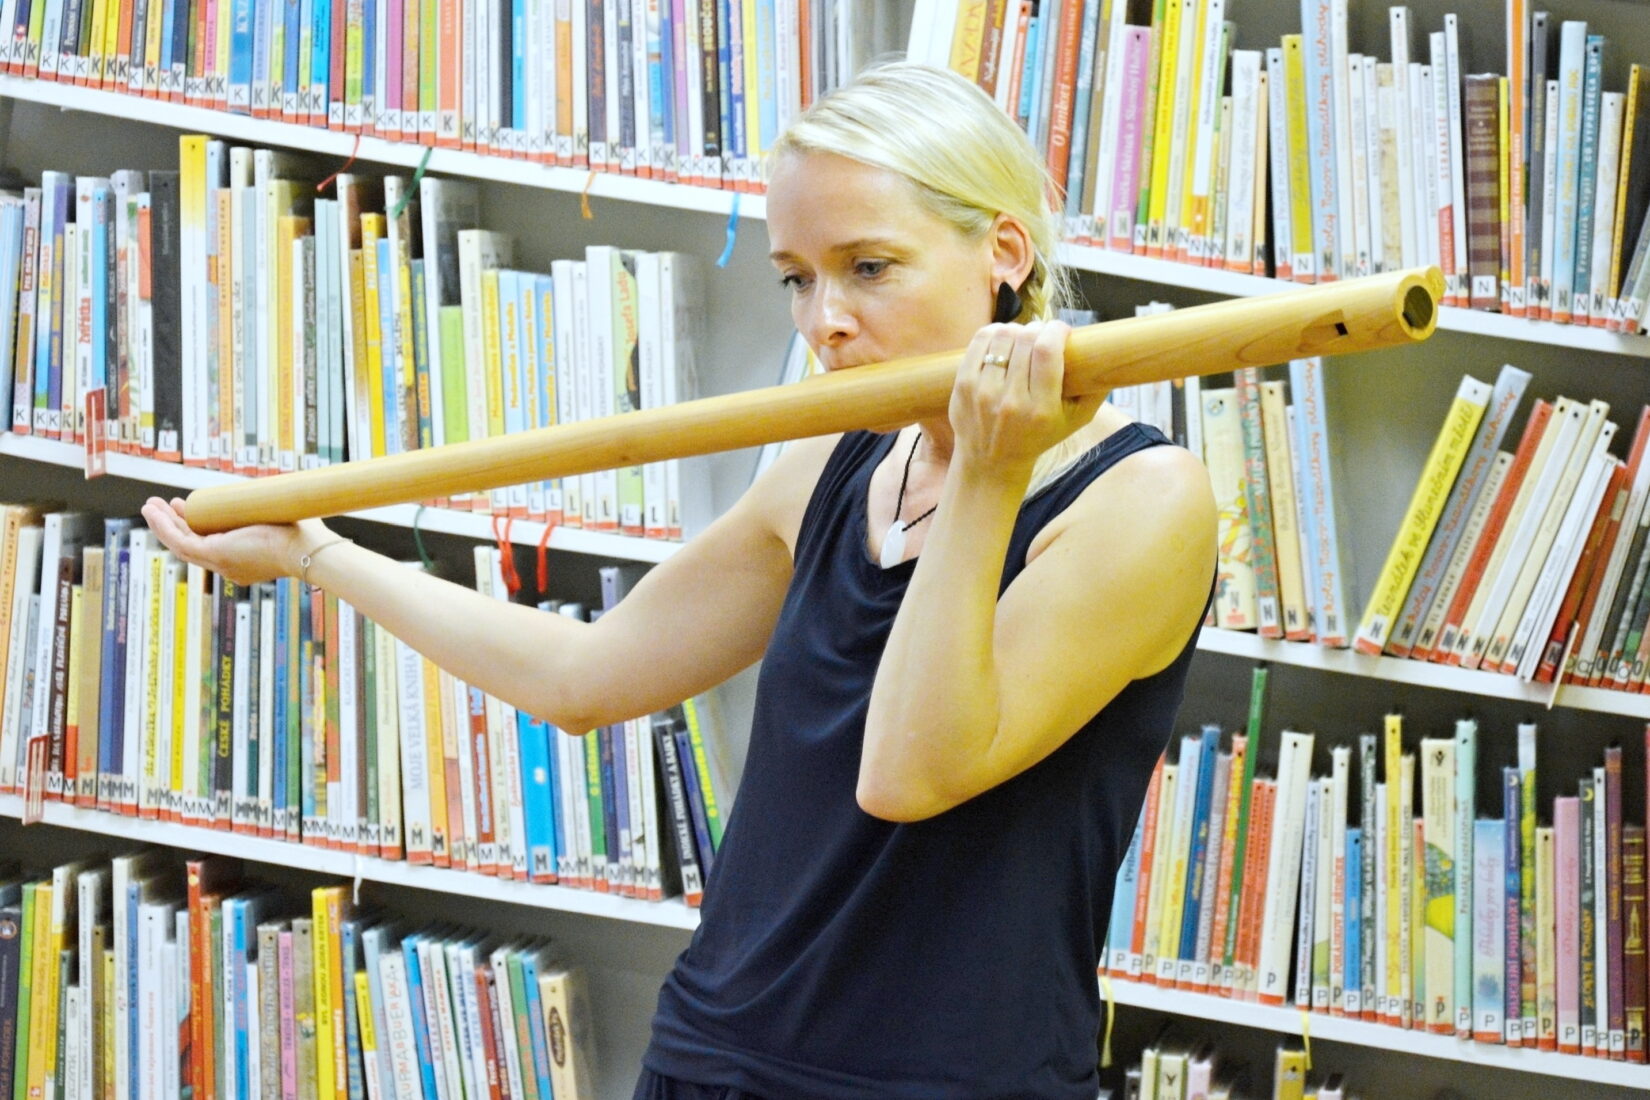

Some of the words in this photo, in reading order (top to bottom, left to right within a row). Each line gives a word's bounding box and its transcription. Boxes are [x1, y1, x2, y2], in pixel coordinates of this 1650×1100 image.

[698, 0, 714, 51] BROUČC
[14, 41, 23, 58] K
[27, 44, 36, 59] K
[43, 56, 51, 66] K
[60, 59, 69, 70] K
[92, 58, 100, 72] K
[129, 72, 137, 84] K
[147, 68, 155, 83] K
[205, 77, 214, 93] K
[285, 98, 293, 109] K
[1583, 77, 1597, 142] VYPRÁVĚLA
[331, 107, 340, 118] K
[348, 110, 355, 120] K
[444, 116, 452, 130] K
[545, 131, 552, 145] K
[1436, 116, 1450, 179] STRAKATÉ
[638, 150, 646, 161] K
[665, 151, 674, 166] K
[1582, 149, 1592, 162] CO
[1580, 176, 1592, 211] Nepil
[1151, 228, 1158, 241] N
[1576, 215, 1590, 274] František
[1479, 281, 1489, 292] N
[16, 409, 24, 420] K
[36, 413, 44, 423] K
[49, 415, 56, 425] K
[163, 435, 170, 448] L
[208, 440, 216, 454] L
[513, 490, 520, 503] L
[550, 493, 558, 506] L
[569, 495, 576, 512] L
[585, 502, 592, 519] L
[603, 500, 609, 516] L
[652, 506, 658, 523] L
[672, 507, 679, 525] L
[1264, 606, 1272, 618] N
[1288, 611, 1296, 622] N
[1372, 623, 1381, 637] N
[1422, 629, 1433, 644] N
[1458, 635, 1467, 649] N
[404, 654, 418, 699] KNIHA
[219, 656, 231, 712] POHÁDKY
[404, 703, 421, 748] VELKÁ
[218, 720, 229, 757] ČESKÉ
[1, 767, 8, 784] L
[410, 750, 423, 791] MOJE
[49, 776, 60, 787] M
[64, 780, 75, 791] M
[82, 779, 93, 794] M
[123, 783, 134, 797] M
[184, 801, 196, 812] M
[218, 797, 228, 811] M
[343, 827, 354, 837] M
[385, 827, 395, 840] M
[412, 829, 422, 843] M
[434, 836, 444, 850] M
[500, 845, 510, 858] M
[536, 854, 546, 869] M
[593, 865, 604, 878] M
[686, 873, 697, 889] M
[1333, 855, 1345, 905] DĚDEČEK
[316, 914, 324, 941] KRTEK
[1507, 897, 1520, 957] POHÁDKY
[1331, 910, 1343, 974] POHÁDKOVÝ
[1116, 953, 1125, 965] P
[1145, 954, 1153, 969] P
[1163, 961, 1173, 972] P
[1181, 964, 1192, 976] P
[1212, 964, 1222, 979] P
[1267, 972, 1276, 986] P
[1333, 987, 1342, 1002] P
[1347, 994, 1357, 1006] P
[1364, 989, 1374, 1004] P
[1389, 998, 1399, 1010] P
[1437, 1002, 1445, 1017] P
[1485, 1014, 1495, 1027] P
[1543, 1018, 1551, 1032] P
[1510, 1023, 1521, 1035] P
[1565, 1026, 1575, 1039] P
[1631, 1029, 1640, 1045] P
